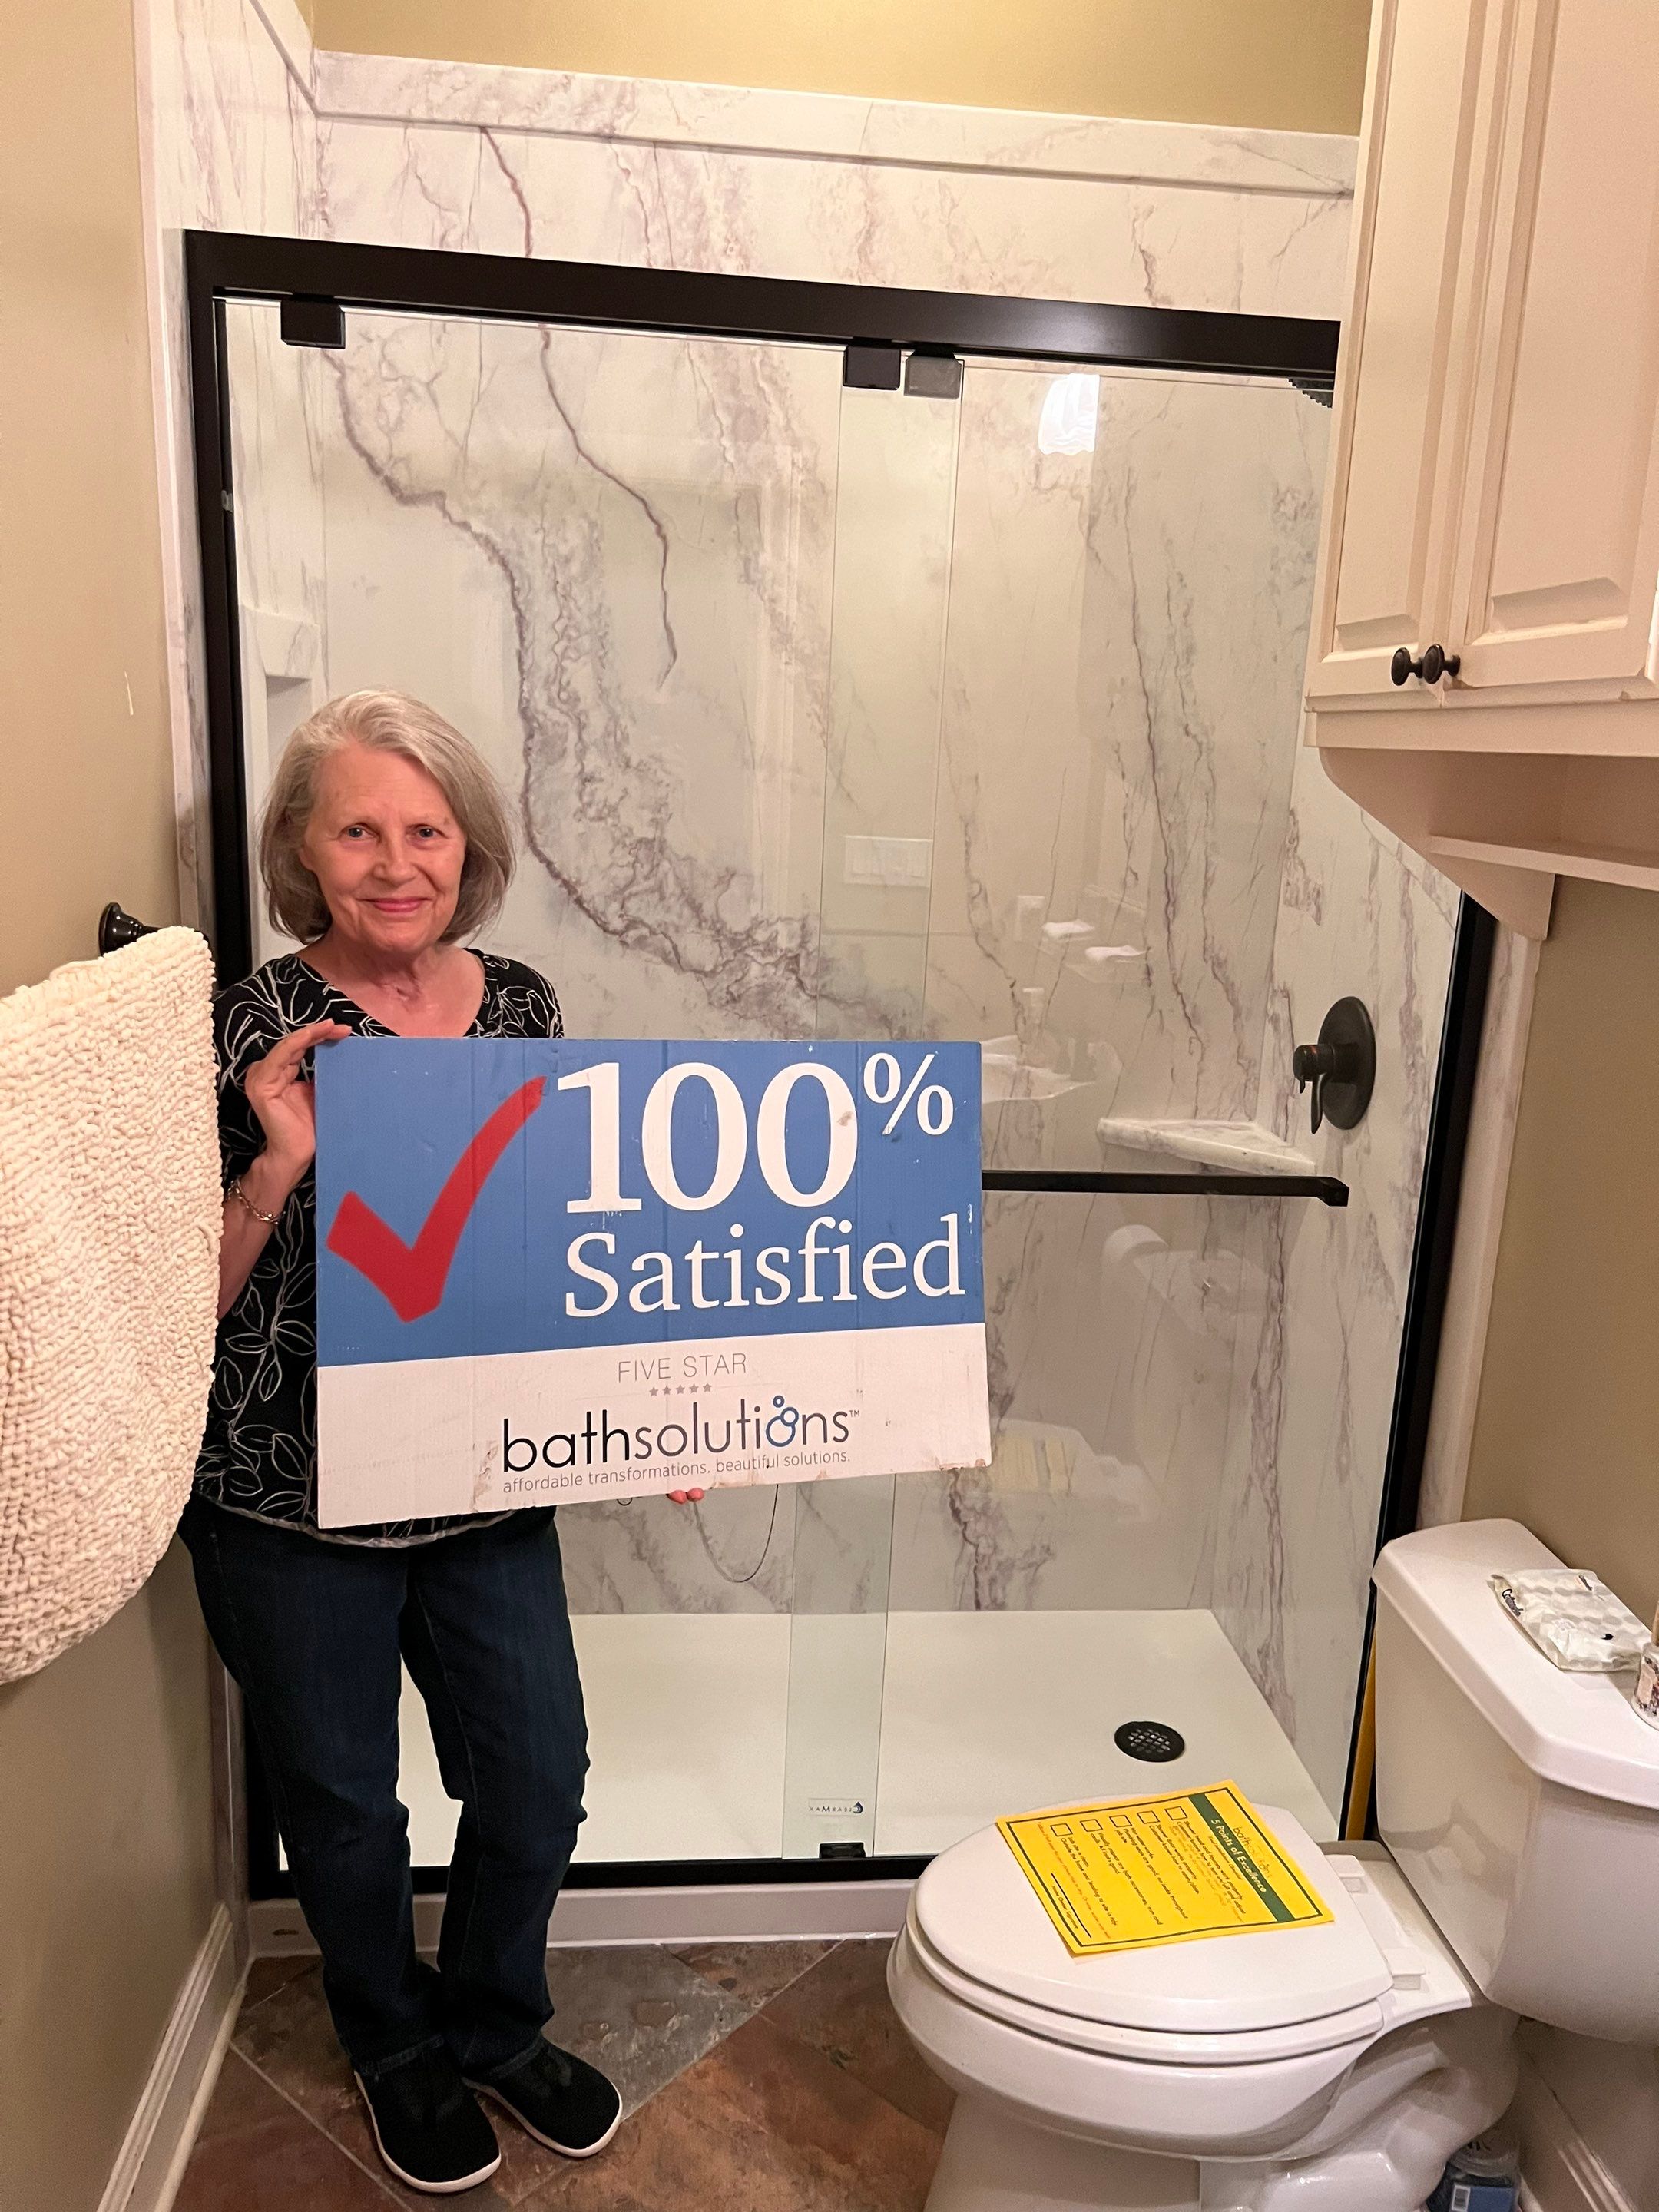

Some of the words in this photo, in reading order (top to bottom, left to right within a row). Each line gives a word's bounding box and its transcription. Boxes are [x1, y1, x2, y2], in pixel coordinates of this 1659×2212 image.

[558, 1051, 955, 1214] 100%
[565, 1213, 966, 1319] Satisfied
[618, 1357, 671, 1383] FIVE
[683, 1353, 747, 1378] STAR
[503, 1472, 584, 1493] affordable
[588, 1461, 710, 1485] transformations.
[715, 1453, 779, 1473] beautiful
[783, 1450, 850, 1468] solutions.
[1216, 1825, 1232, 1846] Points
[1237, 1856, 1266, 1892] Excellence
